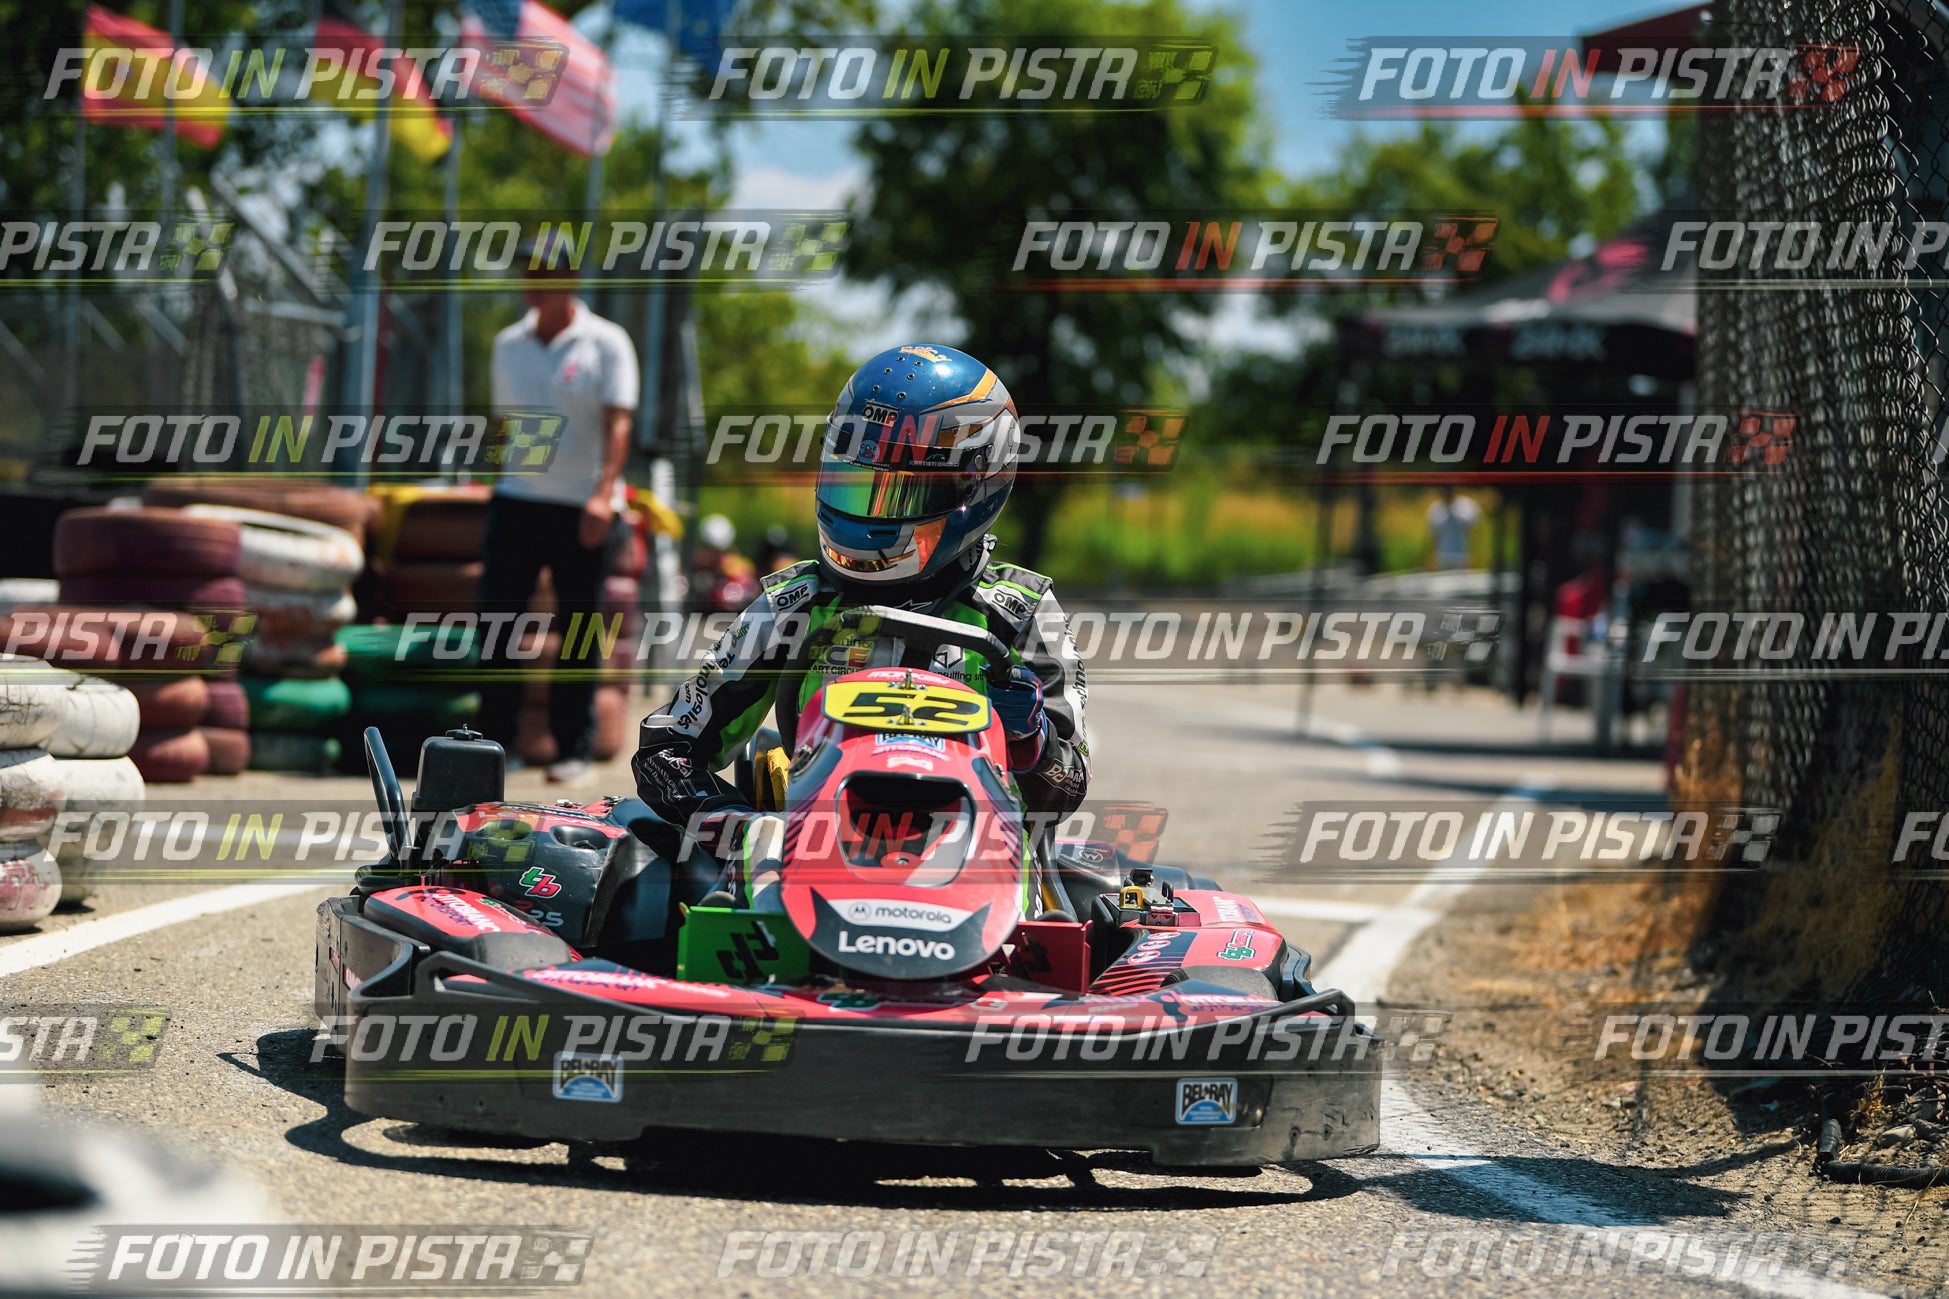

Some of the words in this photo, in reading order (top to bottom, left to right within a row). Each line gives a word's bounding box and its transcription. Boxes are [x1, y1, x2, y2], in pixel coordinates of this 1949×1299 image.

[776, 585, 808, 607] OMP
[994, 593, 1026, 614] OMP
[843, 692, 980, 726] 52
[875, 907, 952, 924] motorola
[838, 930, 955, 960] Lenovo
